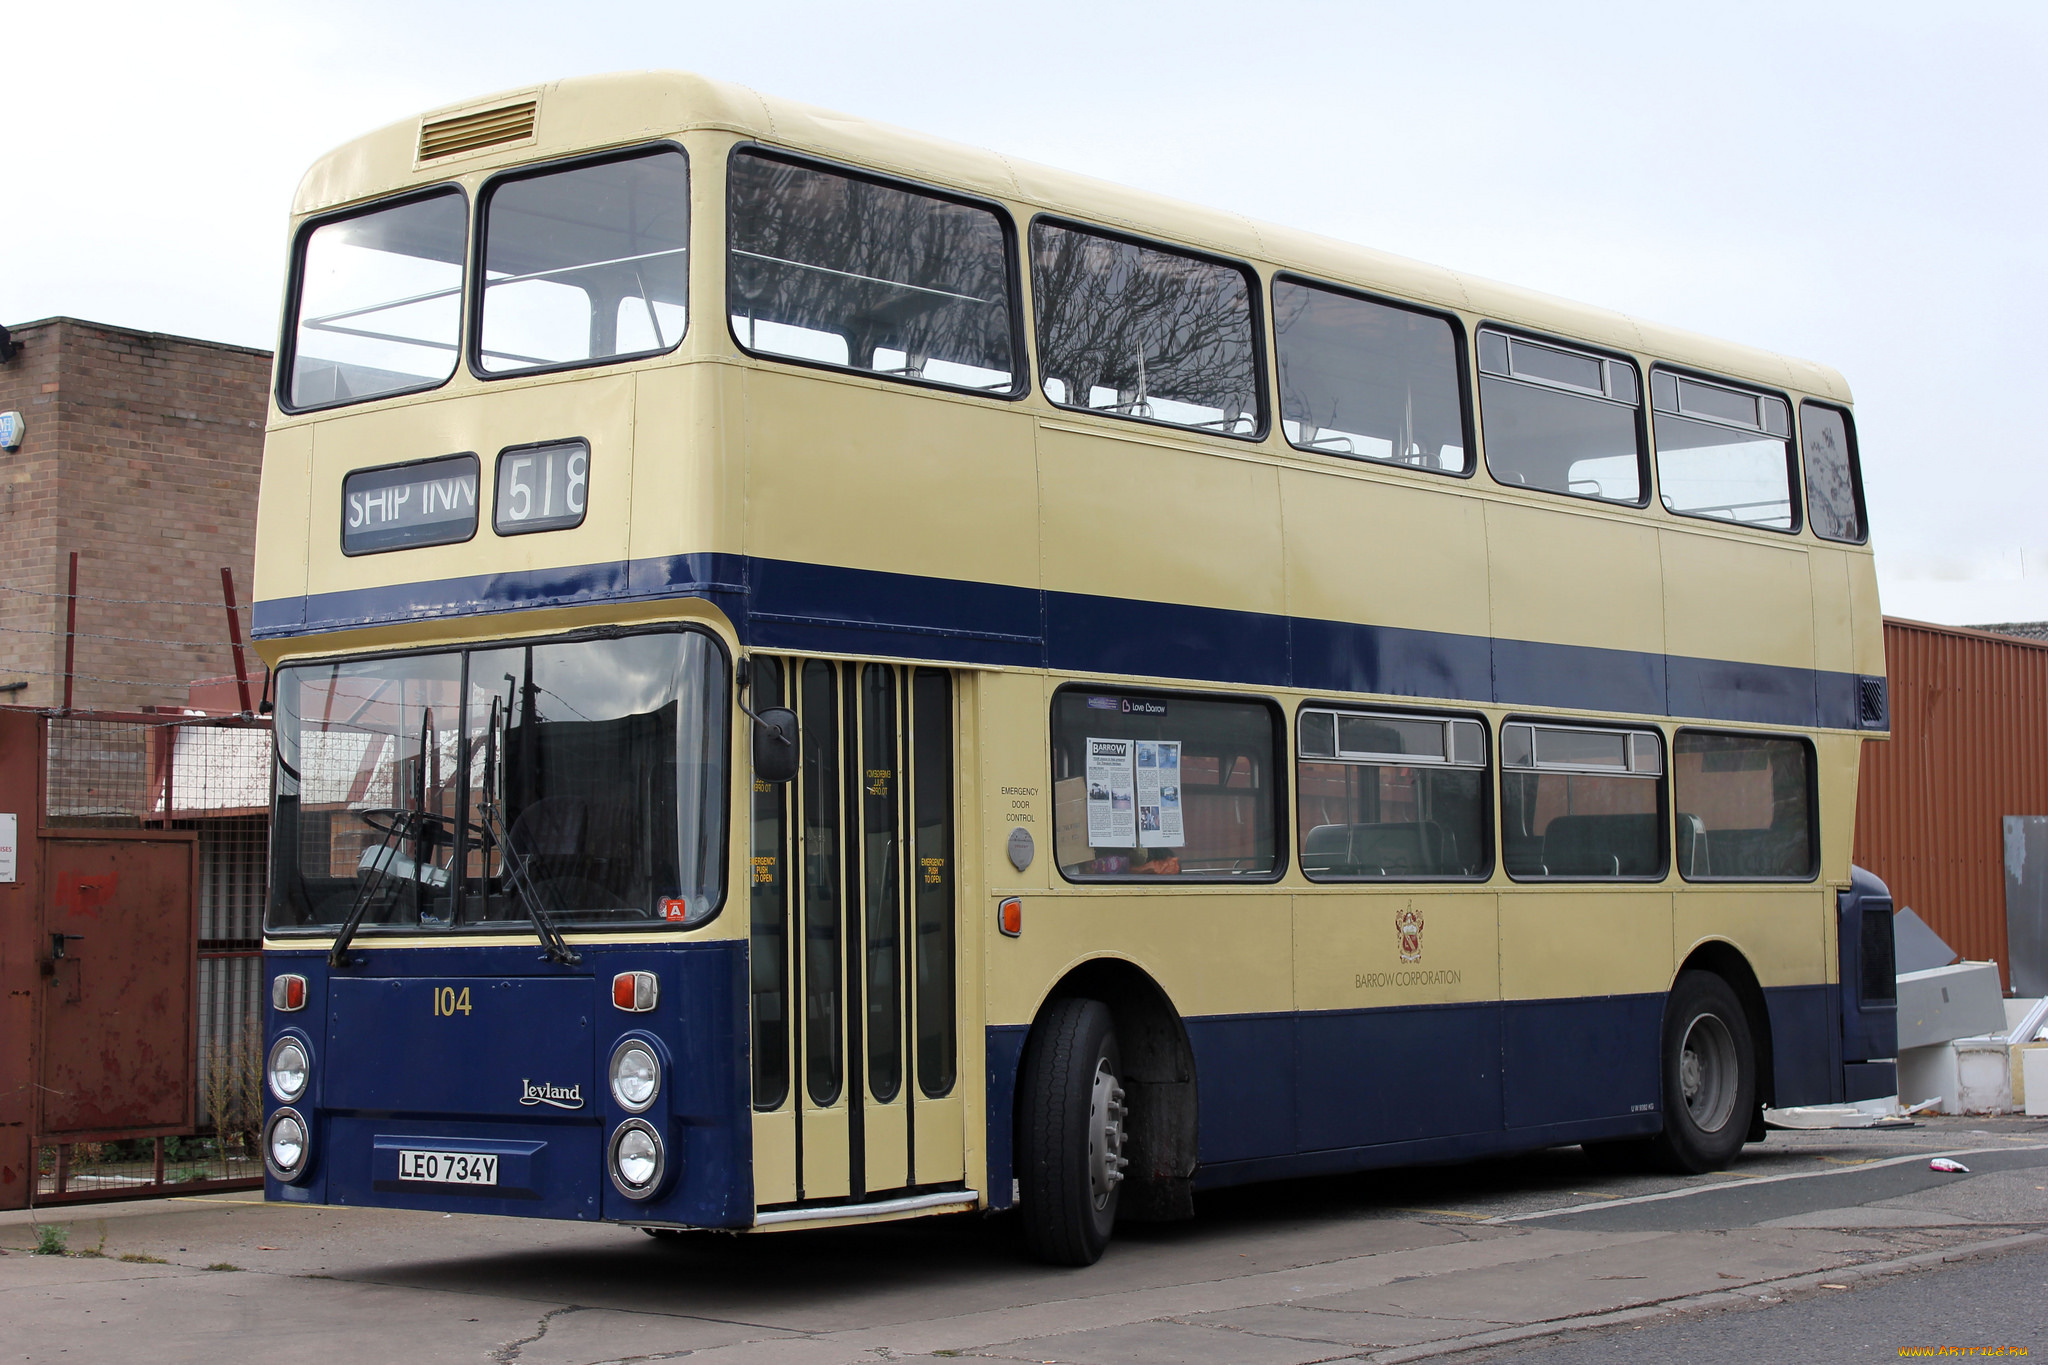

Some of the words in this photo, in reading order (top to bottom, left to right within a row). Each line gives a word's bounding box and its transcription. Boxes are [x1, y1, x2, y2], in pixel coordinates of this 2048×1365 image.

[508, 451, 586, 521] 518
[349, 486, 410, 528] SHIP
[422, 475, 476, 515] INN
[1132, 702, 1144, 712] Love
[1145, 703, 1165, 713] Barrow
[1093, 743, 1126, 754] BARROW
[1001, 786, 1039, 796] EMERGENCY
[1012, 800, 1030, 809] DOOR
[1006, 813, 1035, 822] CONTROL
[750, 857, 776, 866] EMERGENCY
[921, 858, 944, 866] EMERGENCY
[756, 866, 768, 874] PUSH
[928, 867, 938, 875] PUSH
[753, 874, 759, 882] TO
[760, 874, 773, 882] OPEN
[925, 875, 930, 883] TO
[931, 875, 941, 883] OPEN
[670, 905, 682, 916] A
[1355, 973, 1394, 989] BARROW
[1396, 970, 1461, 987] CORPORATION
[434, 986, 473, 1016] 104
[520, 1079, 583, 1107] Leyland
[401, 1154, 438, 1179] LEO
[443, 1156, 495, 1182] 734Y
